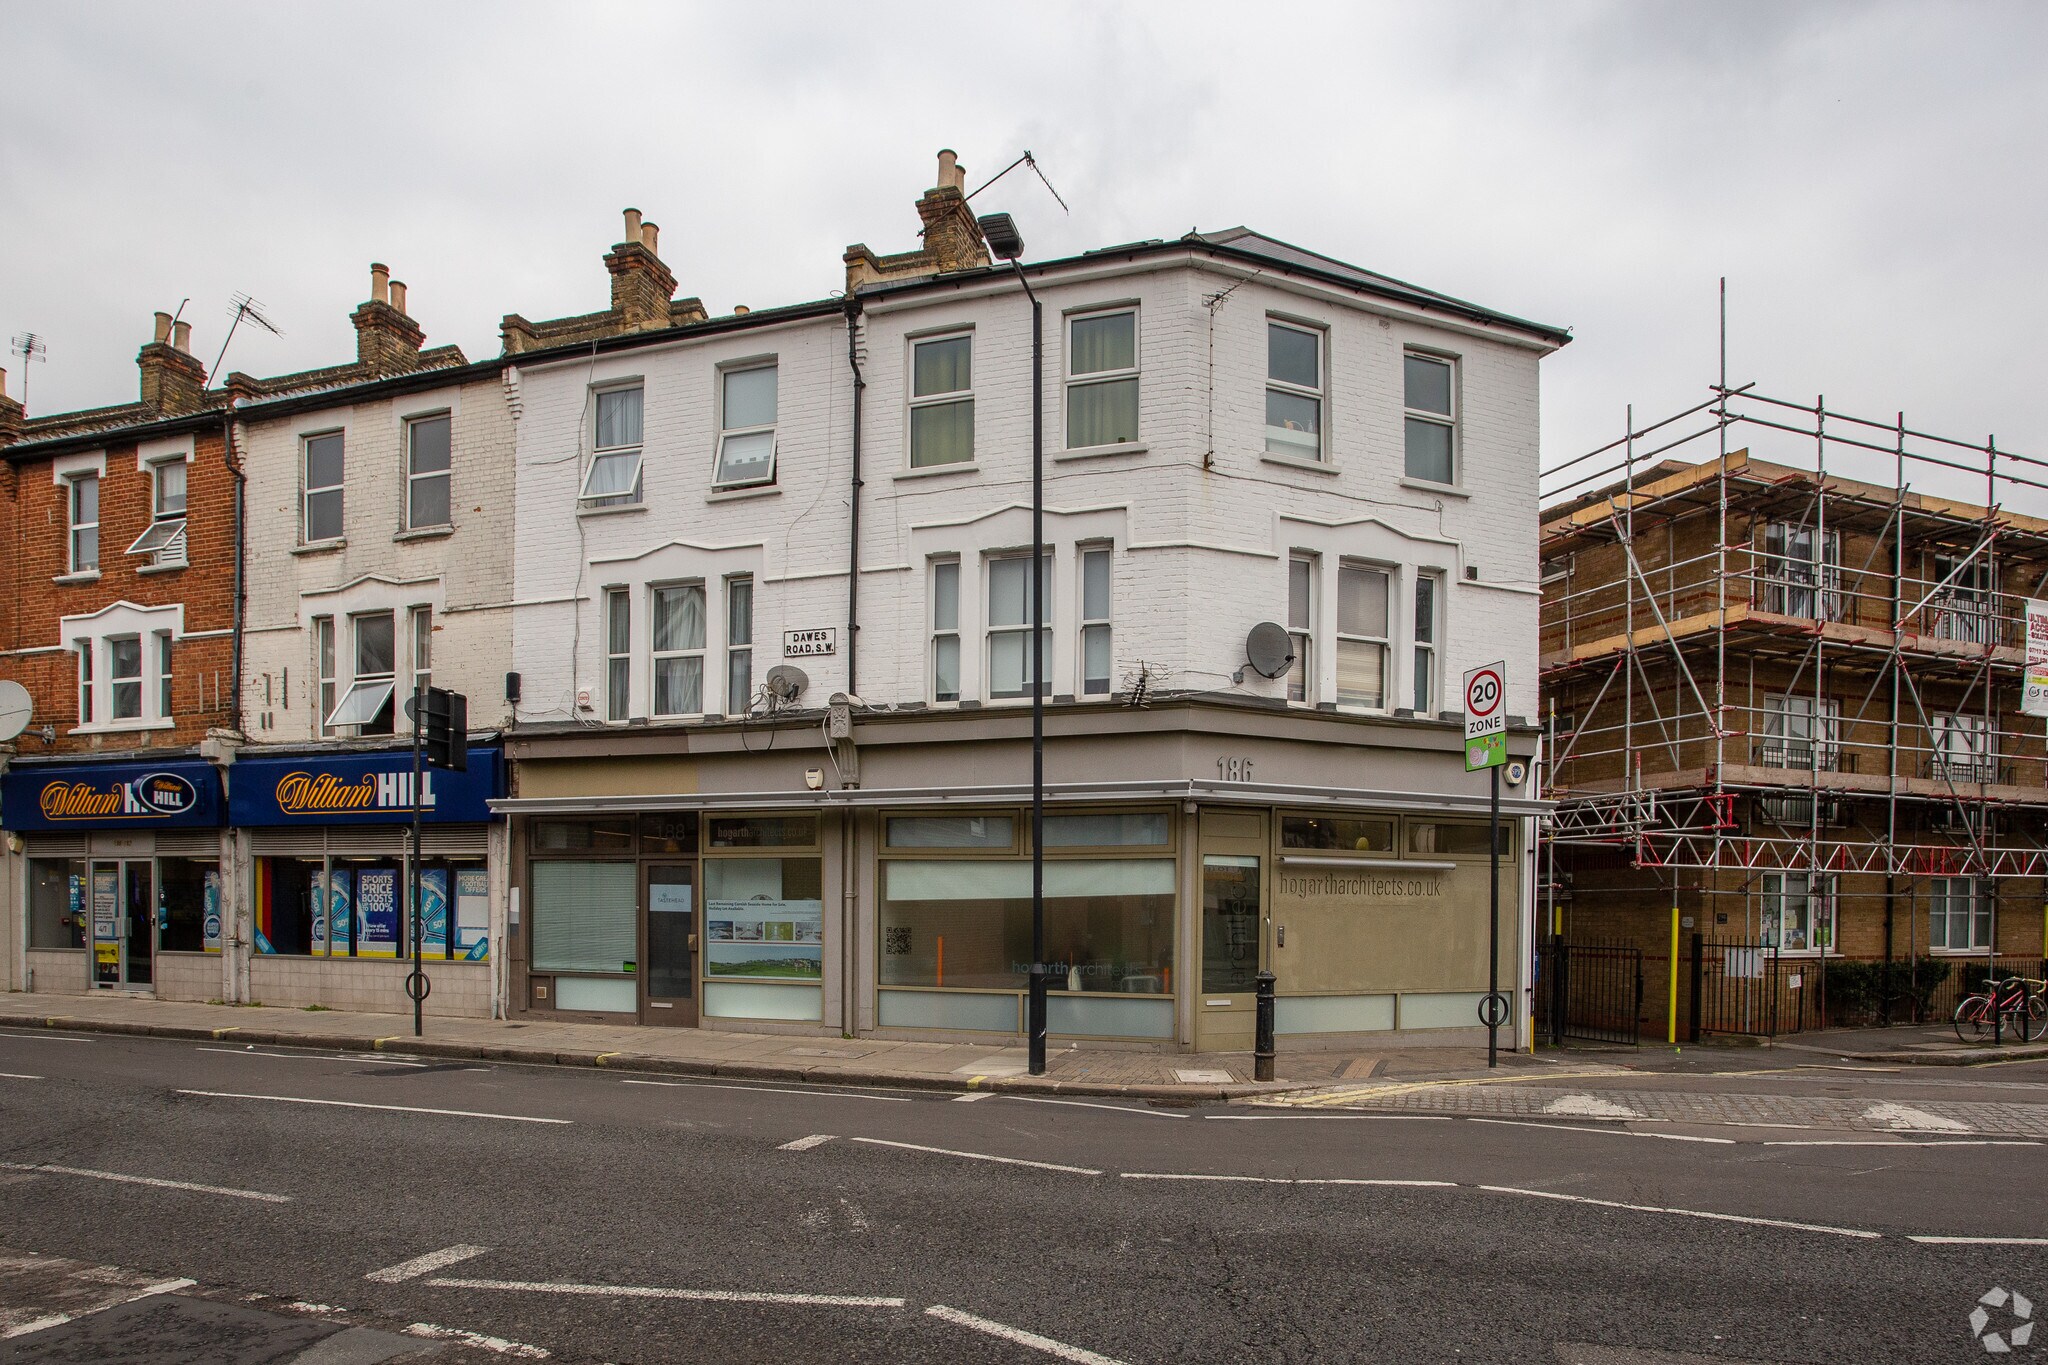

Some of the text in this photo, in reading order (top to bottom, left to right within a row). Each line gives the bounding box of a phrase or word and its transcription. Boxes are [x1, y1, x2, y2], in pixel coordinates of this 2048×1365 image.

[793, 632, 827, 642] DAWES
[815, 642, 834, 652] S.W.
[1472, 681, 1497, 705] 20
[1469, 716, 1501, 734] ZONE
[1216, 755, 1254, 782] 186
[153, 779, 183, 792] William
[276, 771, 377, 810] William
[40, 781, 124, 816] William
[153, 790, 183, 807] HILL
[657, 823, 685, 841] 188
[361, 875, 394, 884] SPORTS
[1280, 872, 1441, 899] hogartharchitects.co.uk
[361, 884, 393, 894] PRICE
[361, 894, 393, 903] BOOSTS
[369, 902, 393, 912] 100%
[423, 894, 436, 913] 40%
[1012, 959, 1069, 975] hoarth
